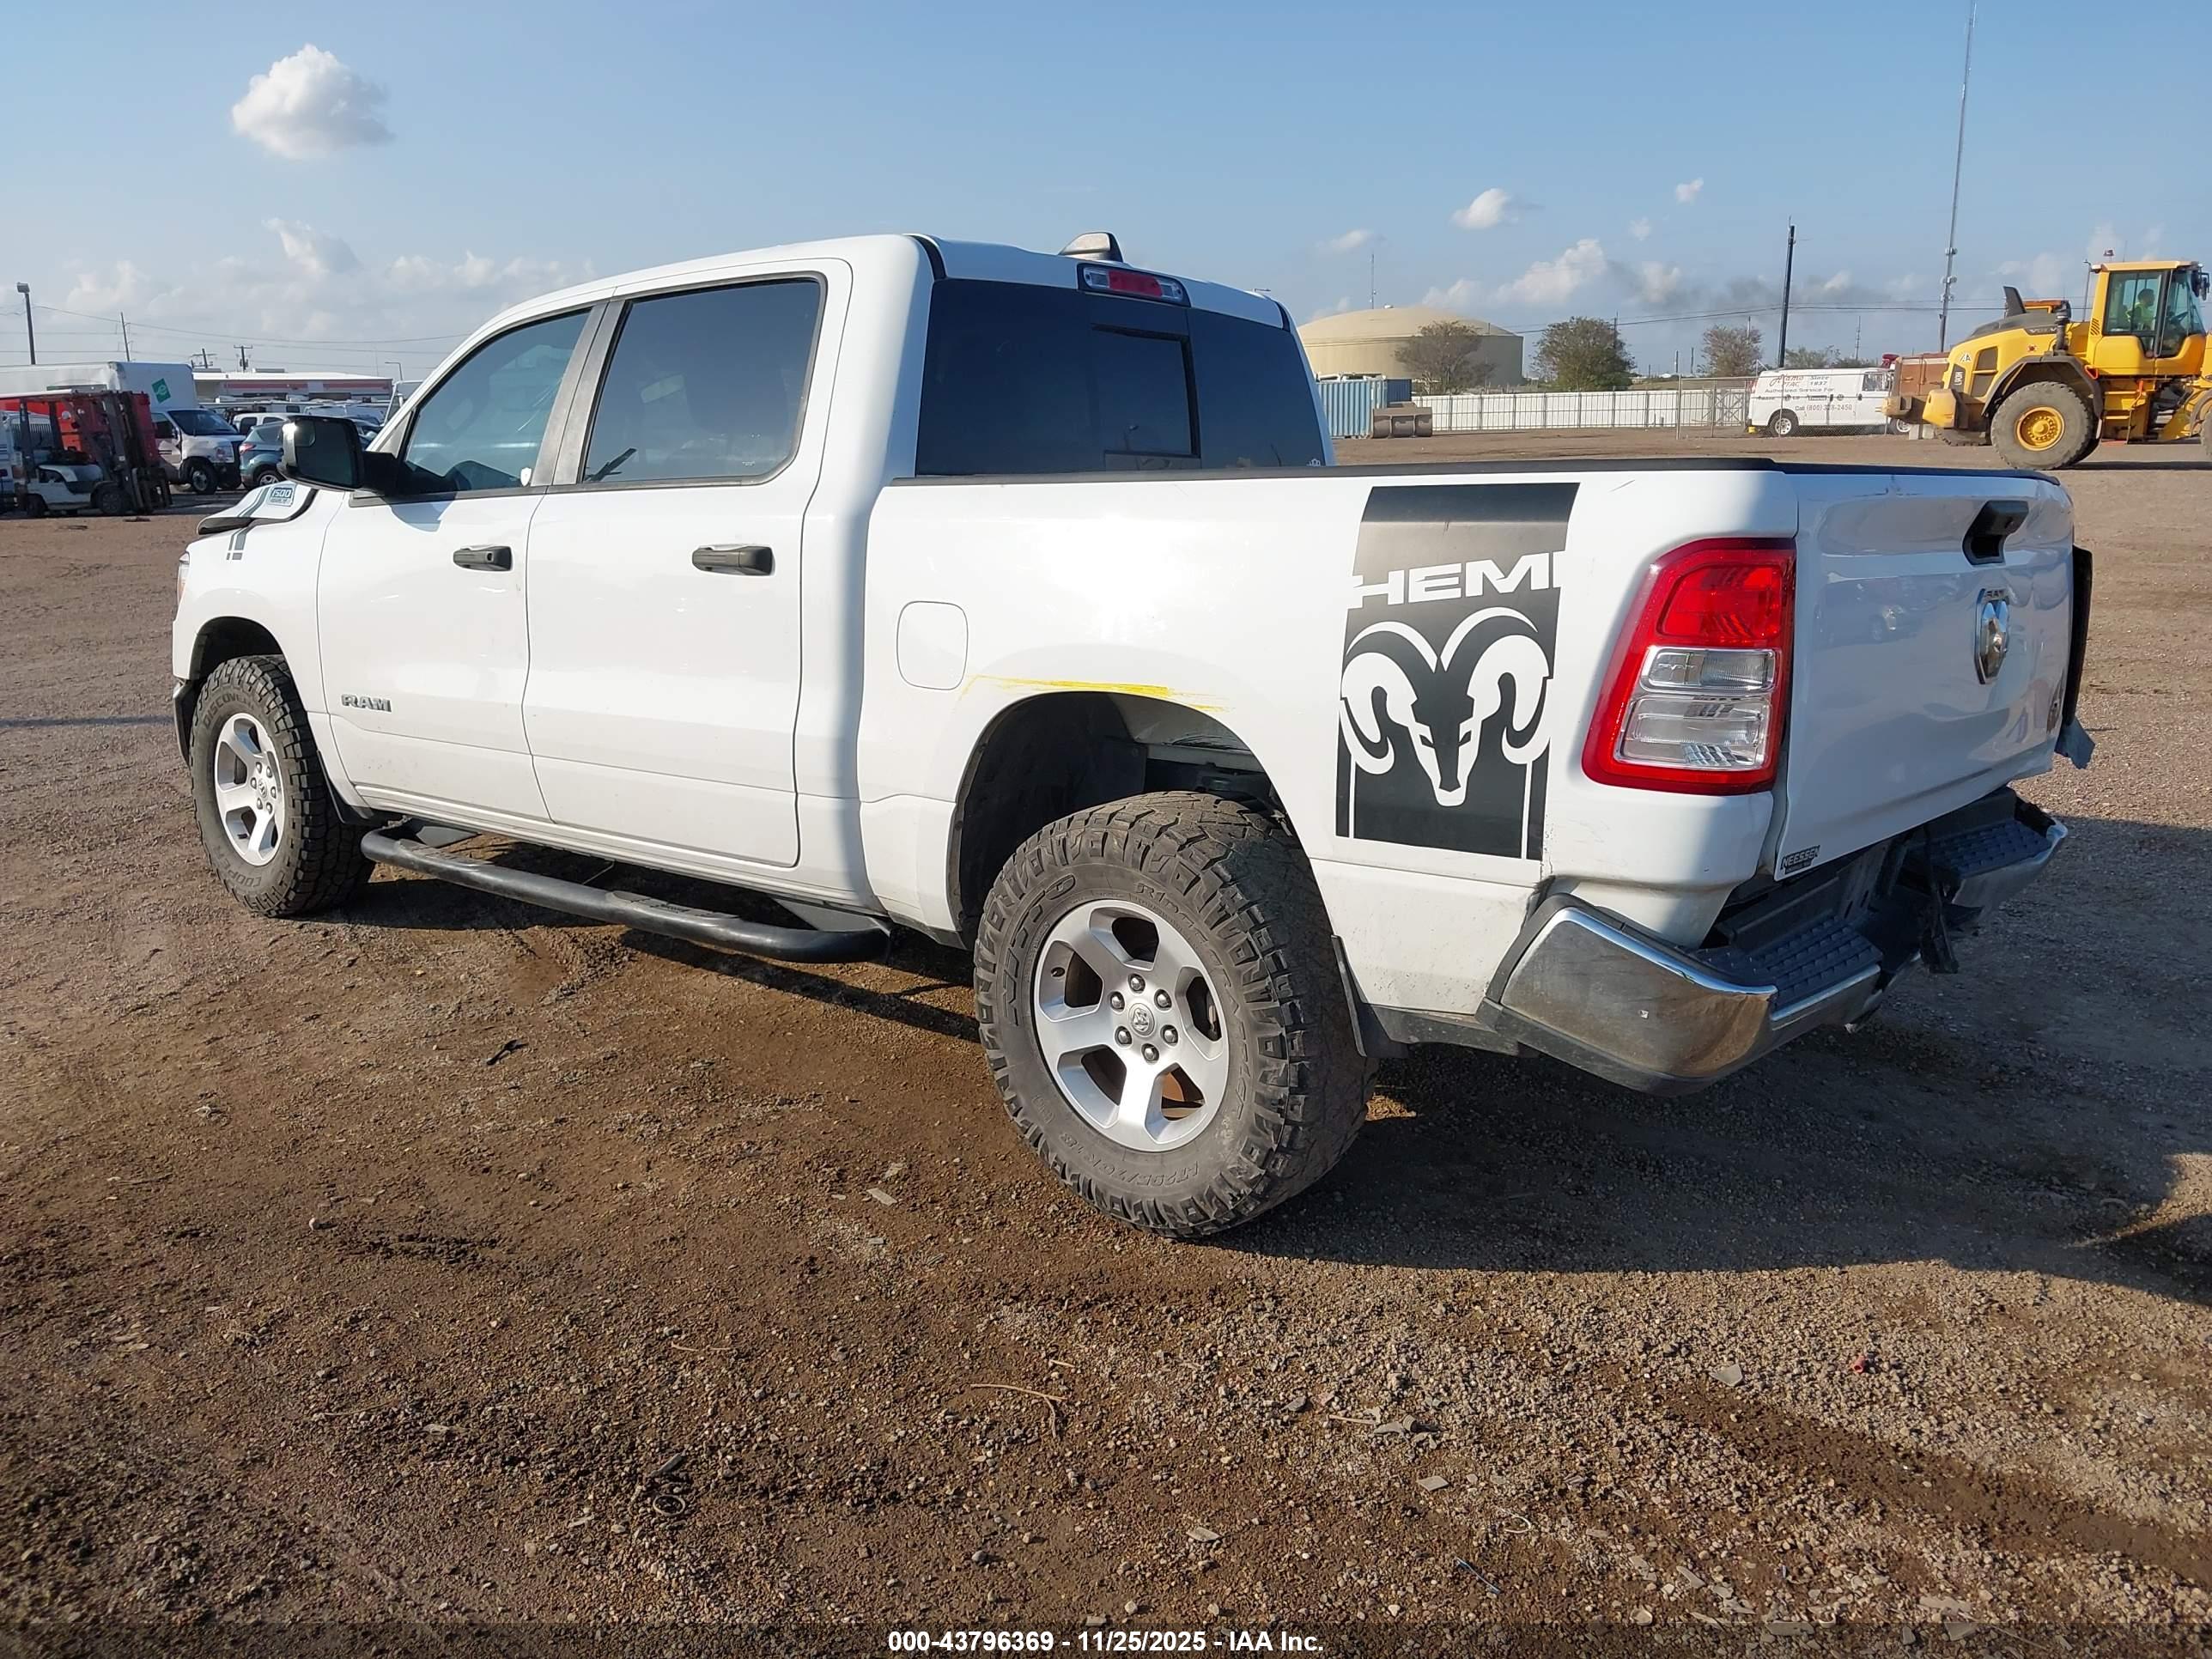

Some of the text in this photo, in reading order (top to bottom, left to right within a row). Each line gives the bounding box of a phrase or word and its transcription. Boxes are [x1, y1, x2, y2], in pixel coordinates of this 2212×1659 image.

[270, 489, 292, 498] 1500
[1347, 550, 1566, 610] HEMI
[341, 694, 392, 713] RAM
